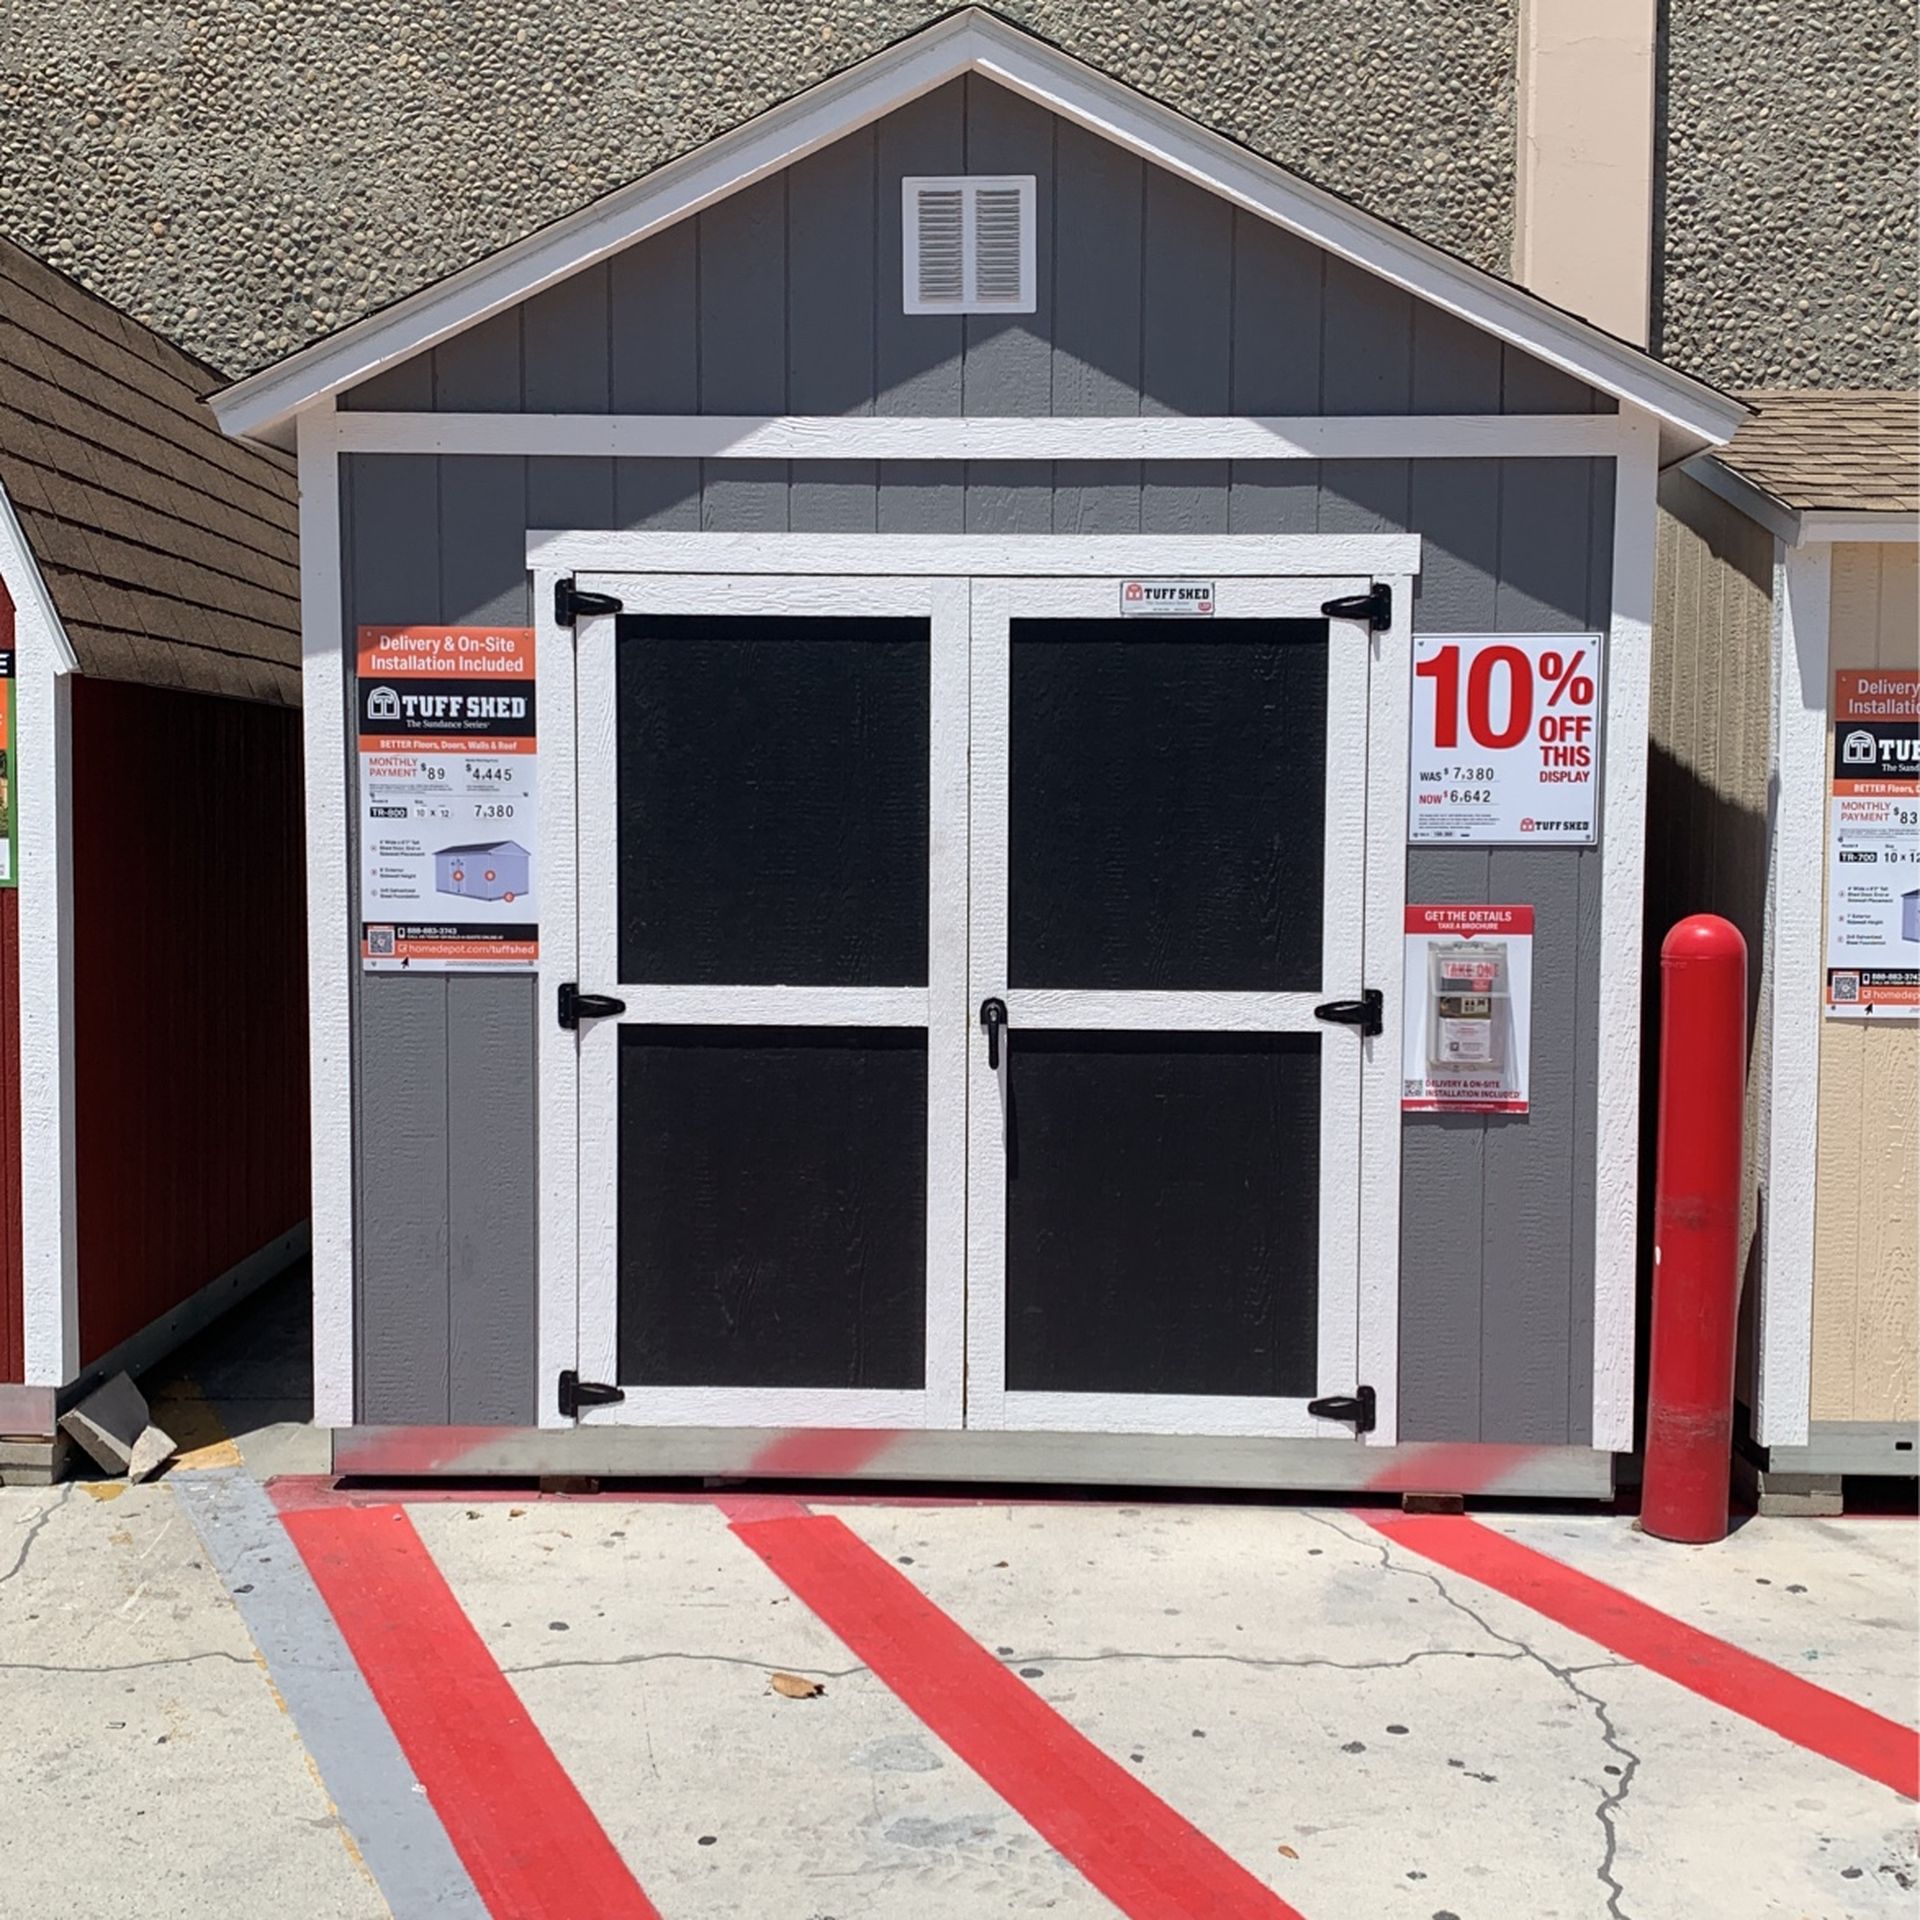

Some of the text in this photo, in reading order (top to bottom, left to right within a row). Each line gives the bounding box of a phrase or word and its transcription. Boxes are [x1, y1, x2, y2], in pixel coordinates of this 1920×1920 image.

[1144, 588, 1209, 599] TUFF SHED
[380, 635, 515, 654] Delivery & On-Site
[371, 655, 524, 672] Installation Included
[1858, 678, 1920, 698] Delivery
[402, 696, 526, 718] TUFF SHED
[406, 720, 489, 729] The Sundance Series
[1539, 716, 1592, 742] OFF
[380, 740, 412, 749] BETTER
[413, 740, 440, 750] Floors,
[441, 740, 467, 750] Doors,
[468, 741, 490, 750] Walls
[498, 741, 518, 750] Roof
[1540, 746, 1591, 767] THIS
[369, 758, 418, 766] MONTHLY
[369, 768, 417, 777] PAYMENT
[1882, 764, 1897, 772] The
[1420, 772, 1442, 781] WAS
[1540, 771, 1590, 783] DISPLAY
[1854, 784, 1914, 794] BETTER Floors,
[1418, 794, 1442, 804] NOW
[1840, 802, 1891, 811] MONTHLY
[440, 810, 450, 818] 12
[1840, 812, 1890, 822] PAYMENT
[1535, 821, 1589, 830] TUFF SHED
[1884, 852, 1898, 863] 10
[1424, 911, 1512, 922] GET THE DETAILS
[1438, 922, 1455, 930] TAKE
[409, 944, 534, 955] homedepot.com/tuffshed
[1426, 1080, 1500, 1088] DELIVERY & ON-SITE
[1426, 1090, 1520, 1098] INSTALLATION INCLUDED
